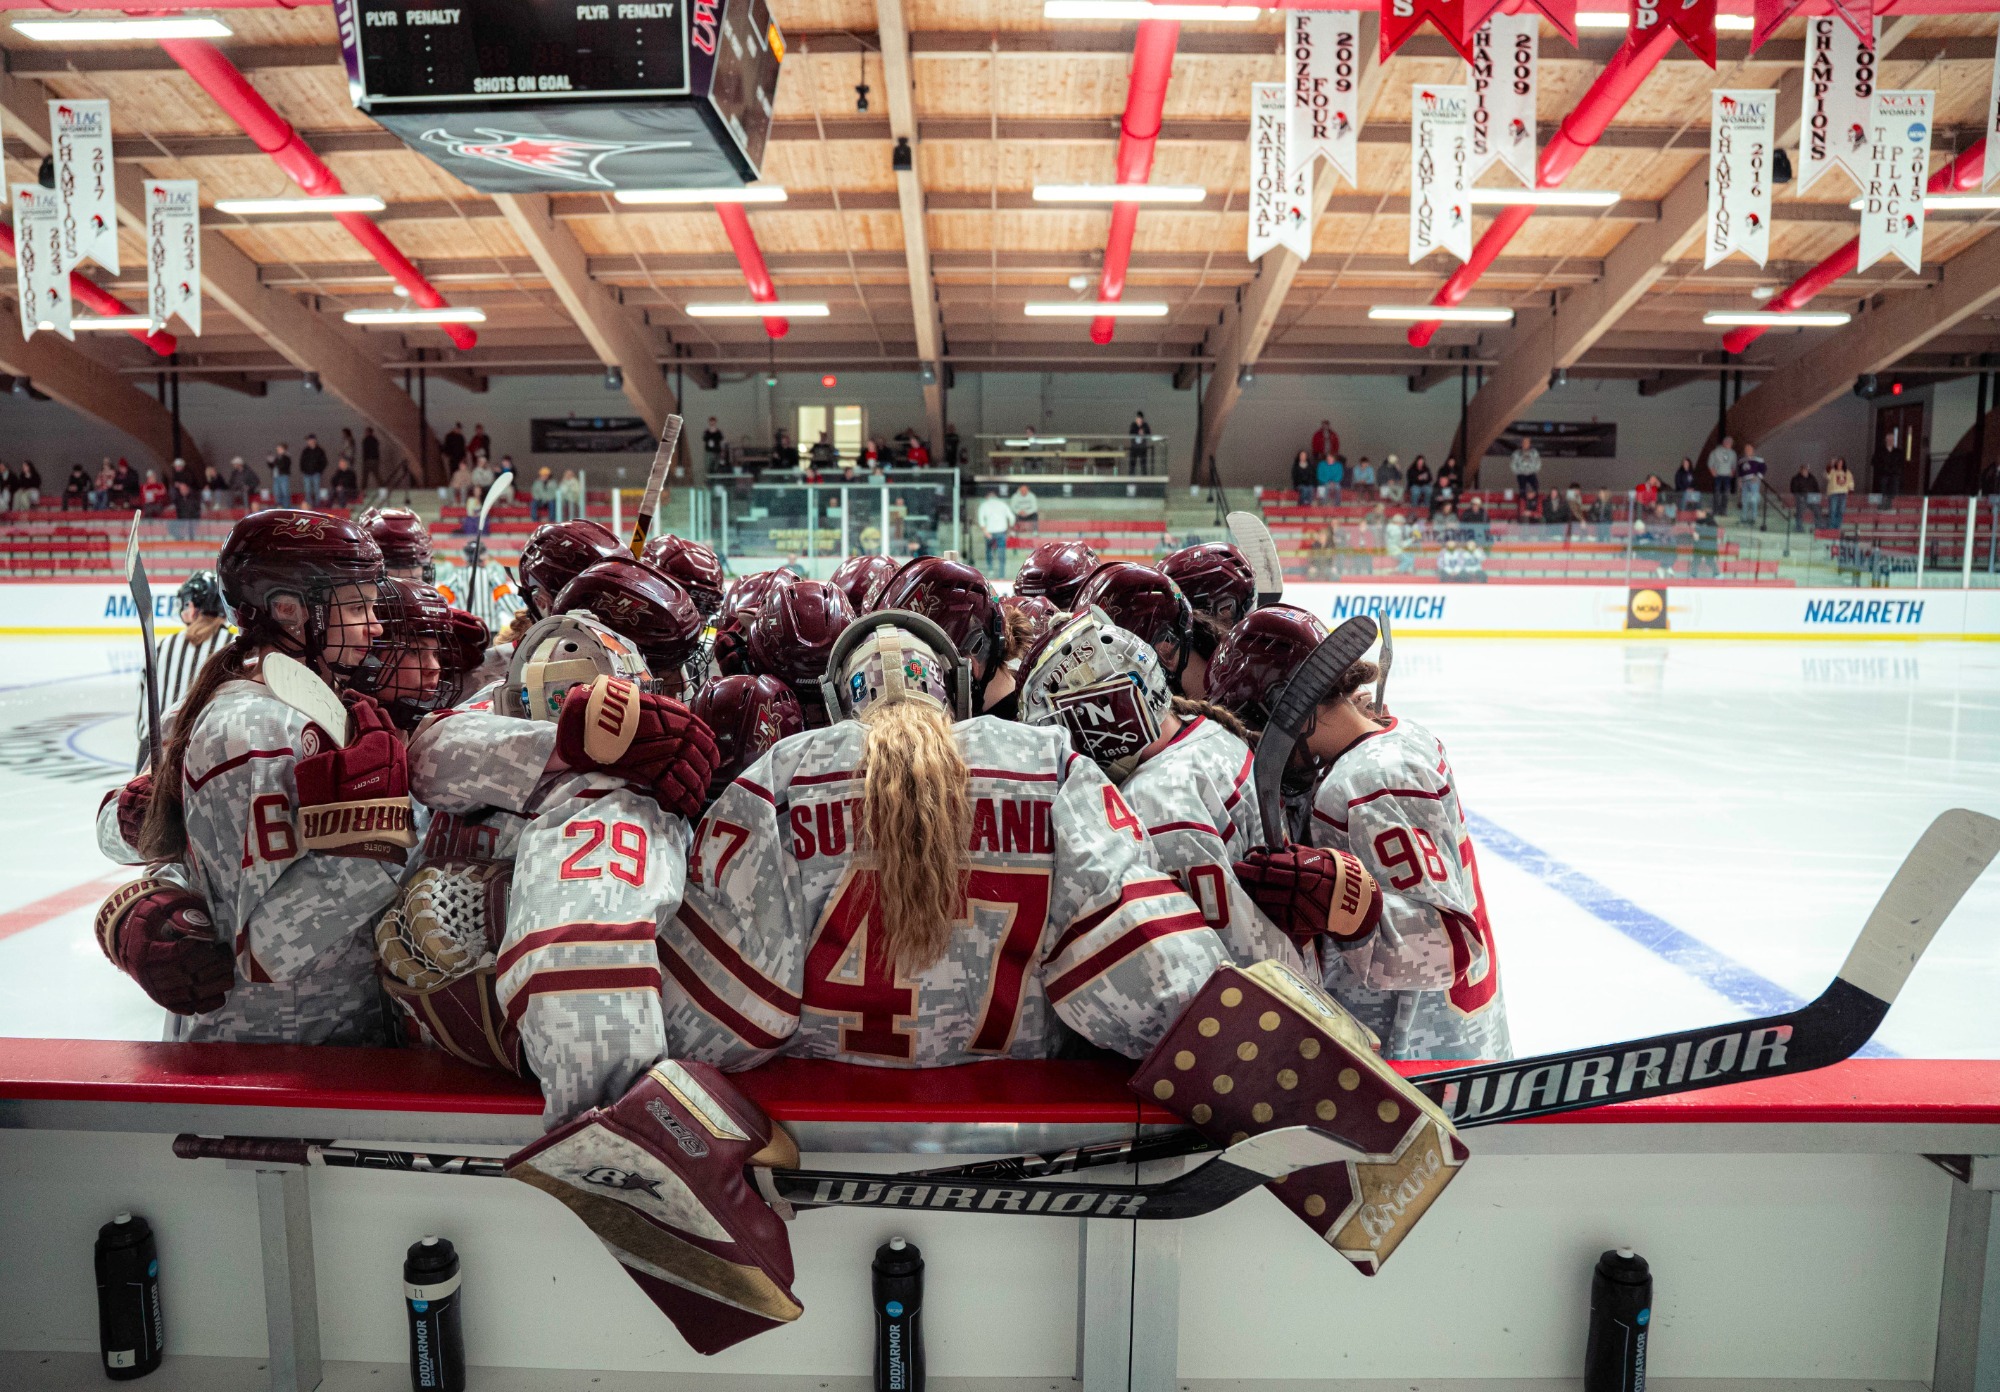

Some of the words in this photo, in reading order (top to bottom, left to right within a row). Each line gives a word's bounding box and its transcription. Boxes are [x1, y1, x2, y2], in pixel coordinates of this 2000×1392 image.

[365, 10, 399, 27] PLYR
[406, 9, 461, 26] PENALTY
[577, 4, 609, 20] PLYR
[618, 3, 674, 19] PENALTY
[473, 76, 515, 93] SHOTS
[517, 76, 536, 91] ON
[537, 74, 572, 91] GOAL
[1295, 16, 1313, 107] FROZEN
[1336, 32, 1353, 93] 2009
[1513, 34, 1531, 95] 2009
[1810, 20, 1834, 160] CHAMPIONS
[1312, 78, 1330, 139] FOUR
[93, 148, 104, 200] 2017
[1257, 115, 1273, 237] NATIONAL
[1417, 120, 1434, 247] CHAMPIONS
[1453, 136, 1466, 191] 2016
[1714, 126, 1731, 251] CHAMPIONS
[1751, 143, 1763, 197] 2016
[1868, 127, 1886, 214] THIRD
[1886, 147, 1903, 233] PLACE
[1910, 147, 1924, 202] 2015
[50, 227, 61, 276] 2023
[184, 223, 194, 271] 2023
[105, 595, 179, 617] AME
[1332, 595, 1446, 619] NORWICH
[1804, 599, 1926, 624] NAZARETH
[1083, 701, 1116, 726] N
[1102, 745, 1130, 758] 1819
[353, 776, 380, 791] COVERT
[364, 842, 391, 854] CADETS
[560, 819, 648, 888] 29
[789, 796, 1054, 861] SUTAND
[1373, 826, 1449, 892] 98
[800, 867, 1052, 1061] 47
[1441, 1024, 1794, 1122] WARRIOR
[813, 1180, 1148, 1217] WARRIOR
[417, 1320, 432, 1387] BODYARMOR
[889, 1324, 901, 1390] BODYARMOR
[1634, 1332, 1647, 1392] ODYARMOR
